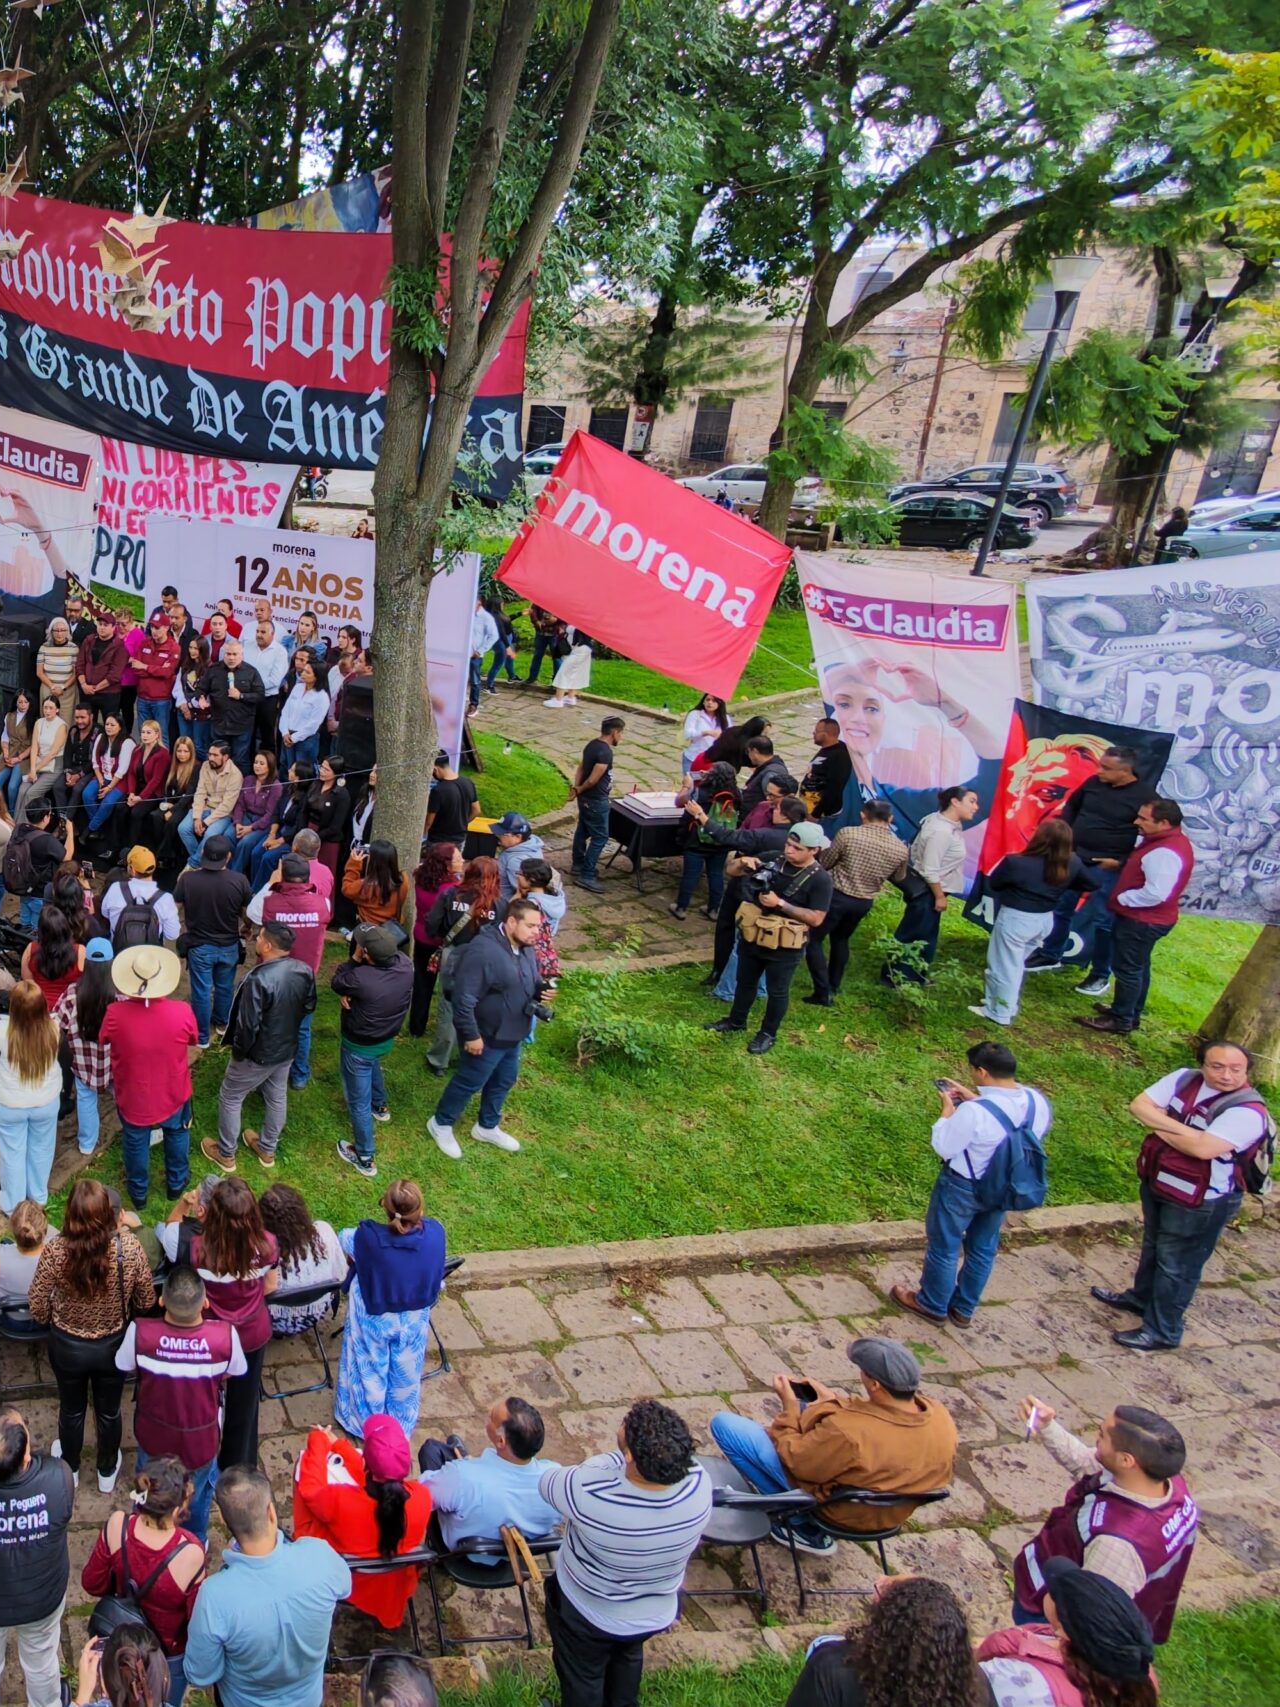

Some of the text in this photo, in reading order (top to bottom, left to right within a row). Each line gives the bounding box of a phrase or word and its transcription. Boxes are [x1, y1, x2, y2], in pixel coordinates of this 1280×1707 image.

[20, 323, 175, 426] Grande
[186, 363, 249, 444] De
[101, 475, 127, 510] NI
[97, 504, 120, 531] NI
[272, 543, 317, 558] morena
[553, 488, 756, 629] morena
[235, 555, 364, 602] 12 AÑOS
[271, 592, 363, 622] HISTORIA
[275, 911, 319, 922] morena
[159, 1335, 210, 1351] OMEGA
[9, 1492, 46, 1512] Peguero
